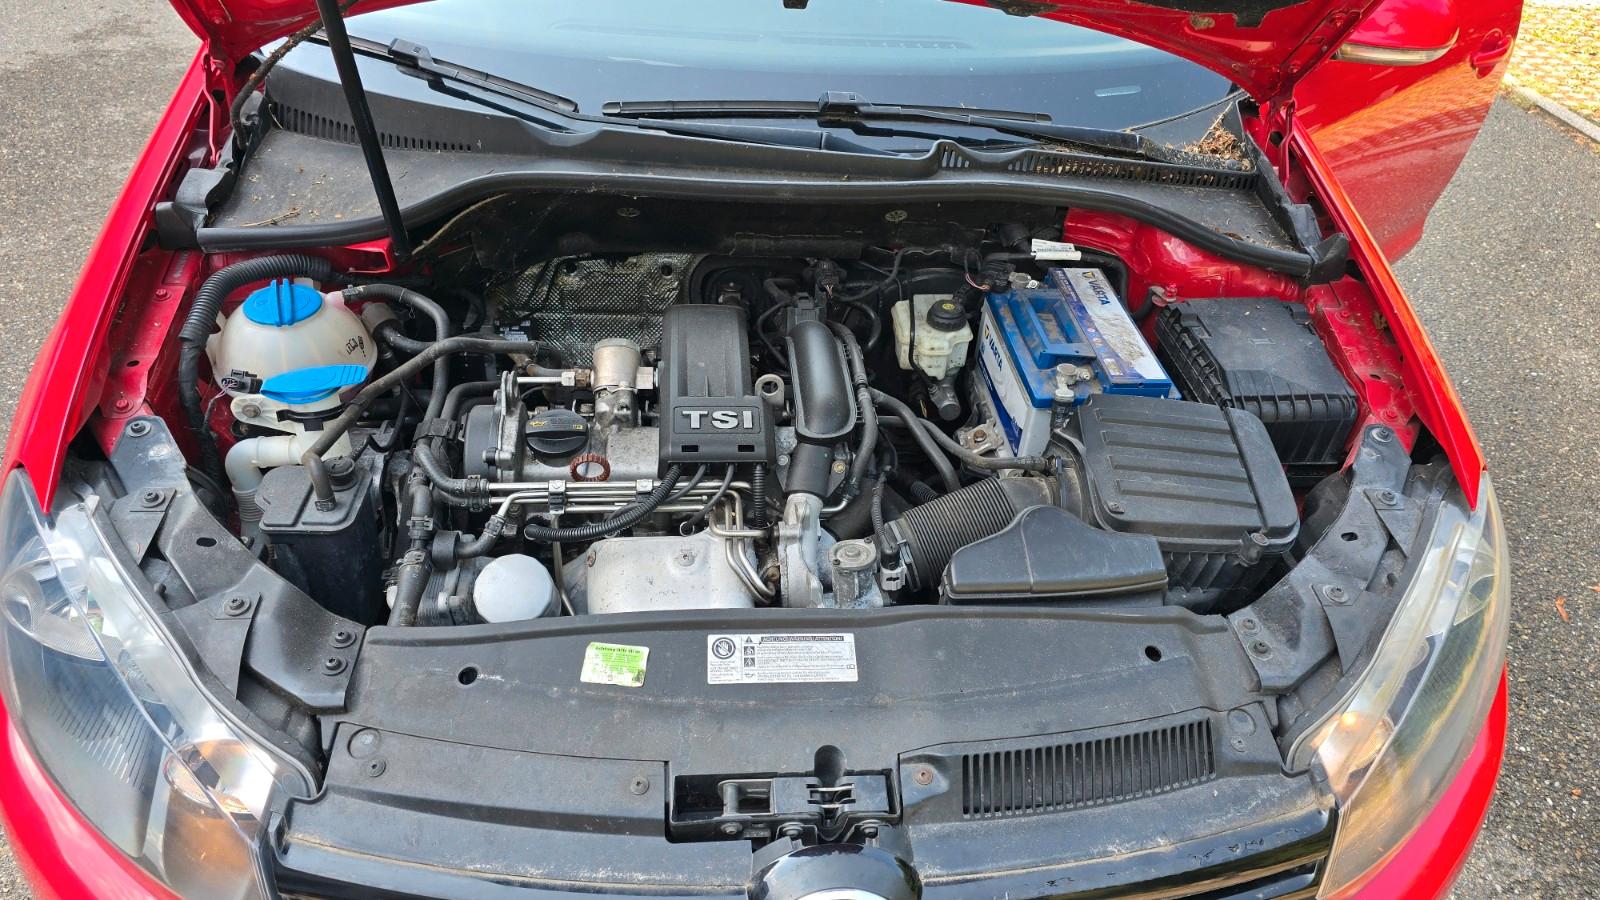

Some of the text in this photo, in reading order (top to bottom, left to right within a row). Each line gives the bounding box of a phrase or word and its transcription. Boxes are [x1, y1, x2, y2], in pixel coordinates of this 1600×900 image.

[1088, 280, 1111, 305] VARTA
[989, 334, 1003, 372] VARTA
[682, 410, 753, 429] TSI
